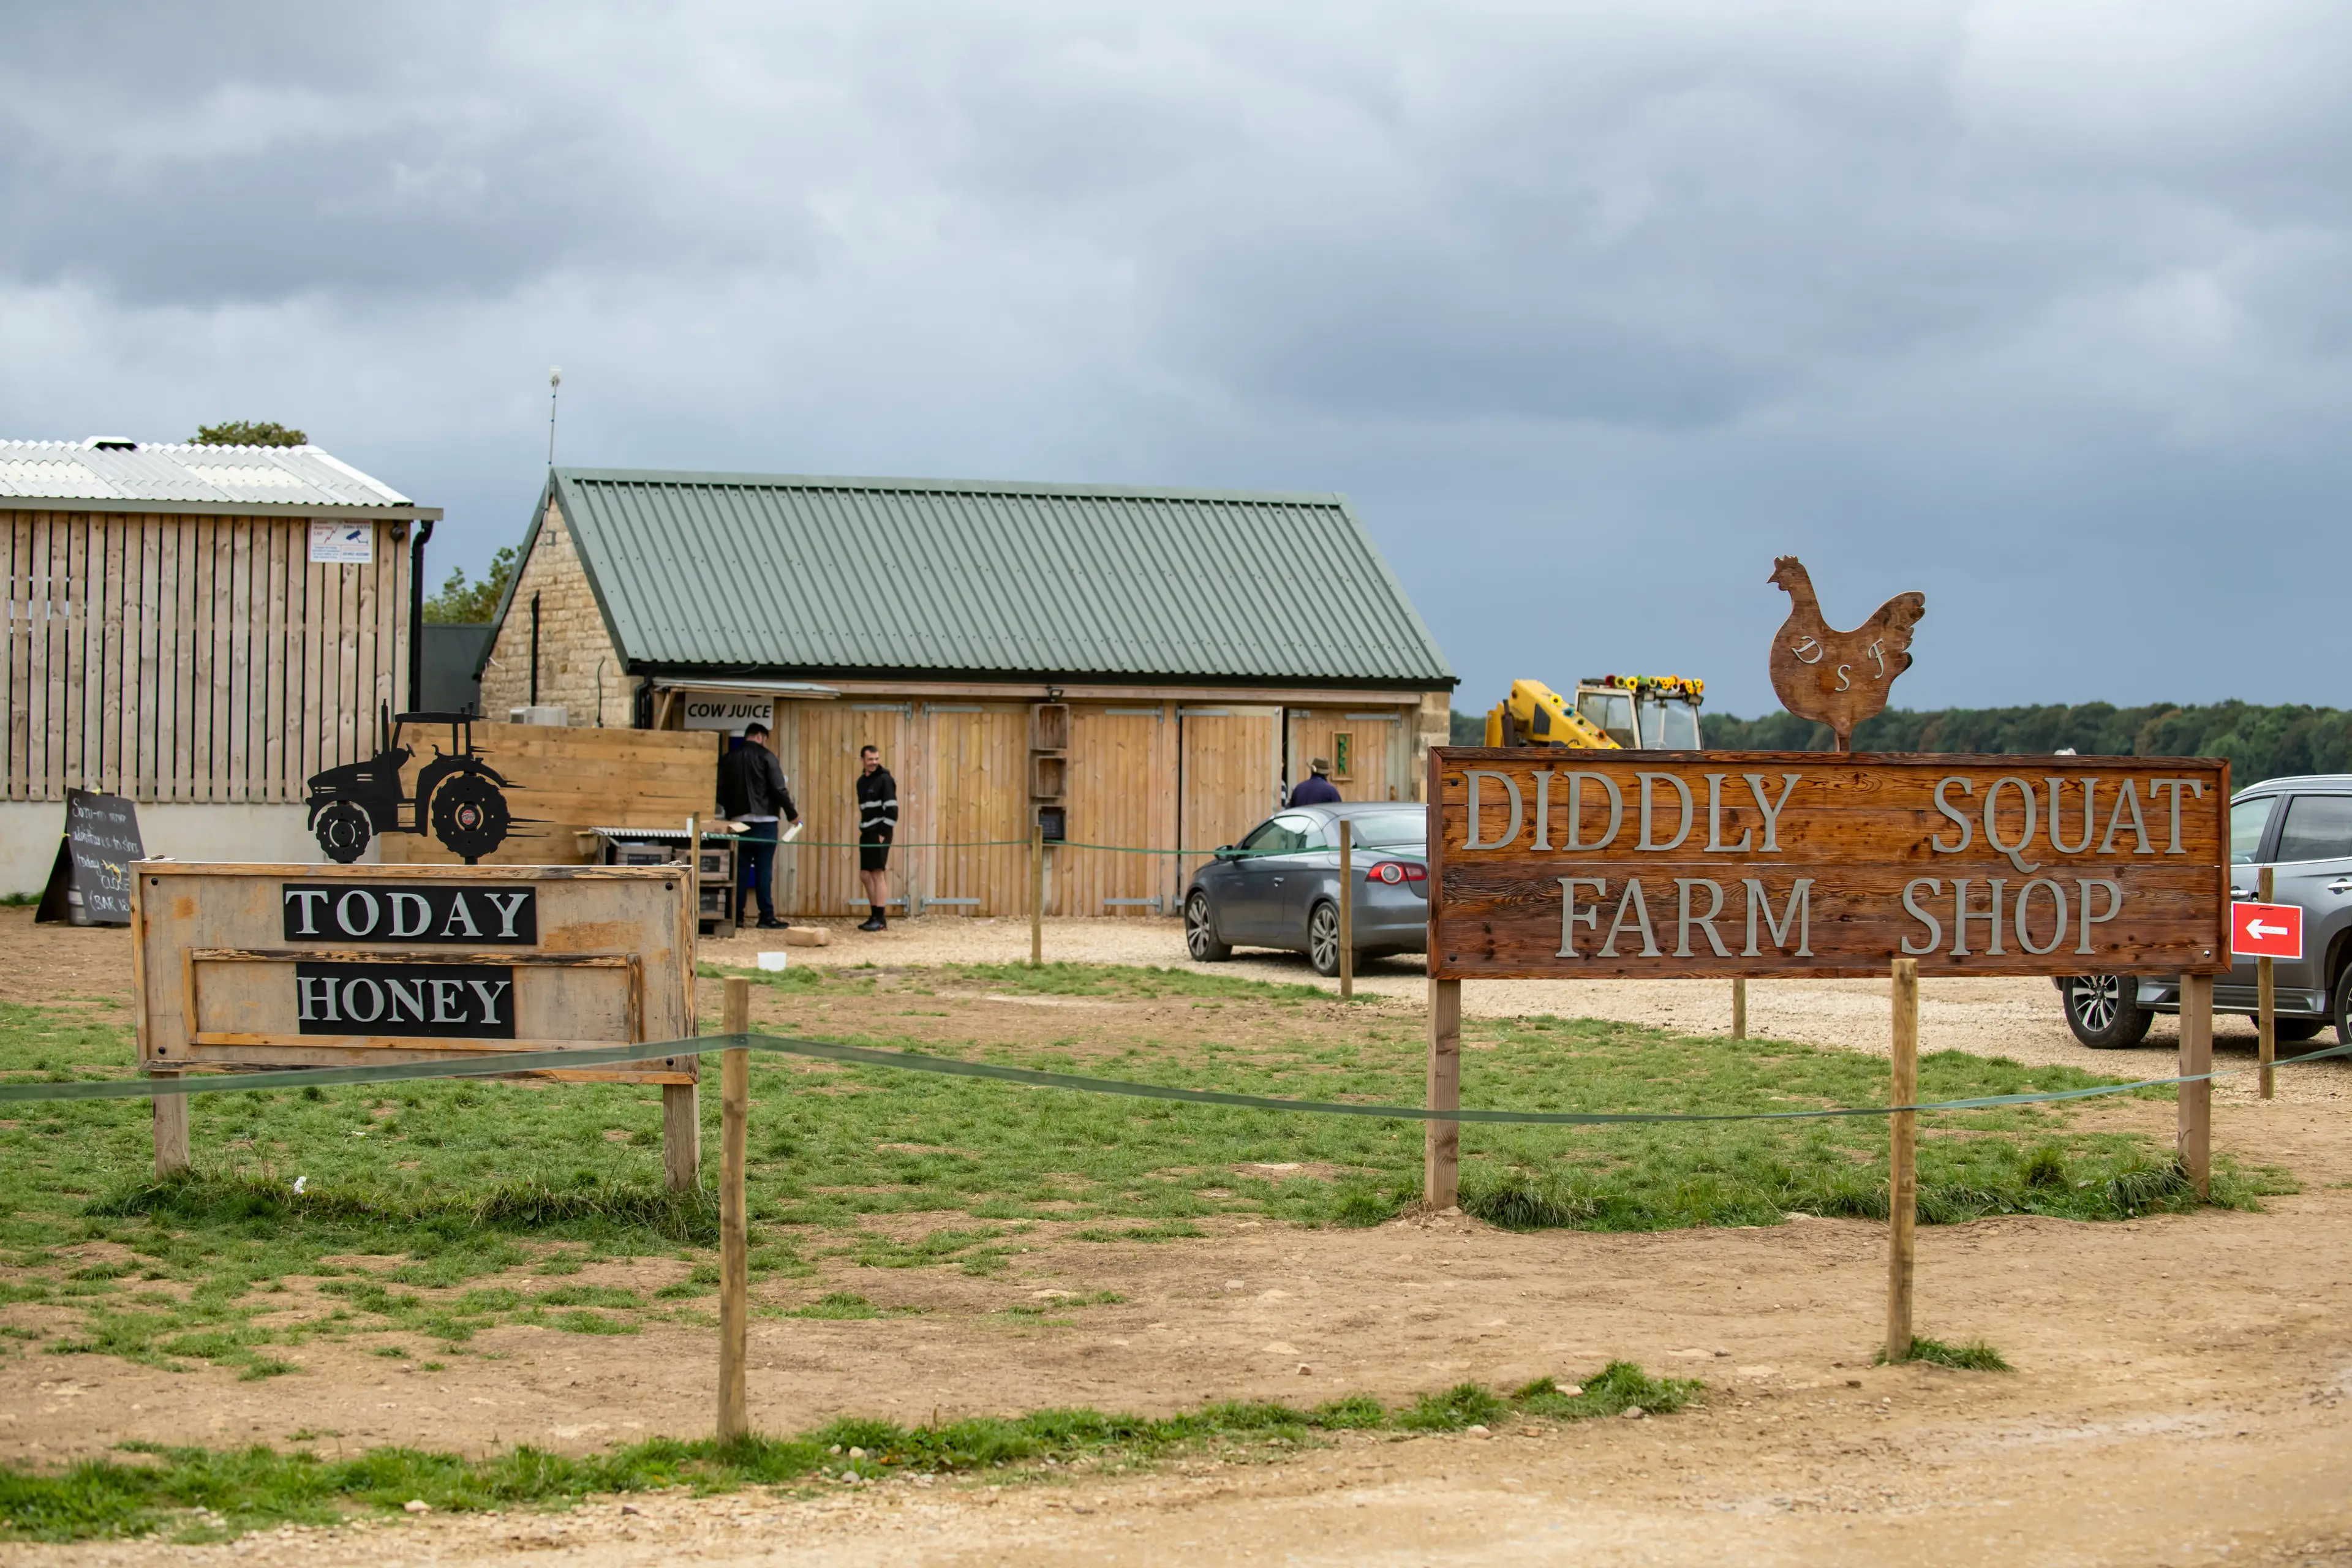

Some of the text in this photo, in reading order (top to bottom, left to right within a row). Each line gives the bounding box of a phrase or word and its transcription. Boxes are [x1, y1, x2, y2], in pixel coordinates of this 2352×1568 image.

[1791, 636, 1885, 692] D S F
[688, 704, 772, 718] COW JUICE
[1461, 770, 2202, 873] DIDDLY SQUAT
[285, 890, 529, 937] TODAY
[1555, 877, 2122, 957] FARM SHOP
[296, 977, 511, 1024] HONEY
